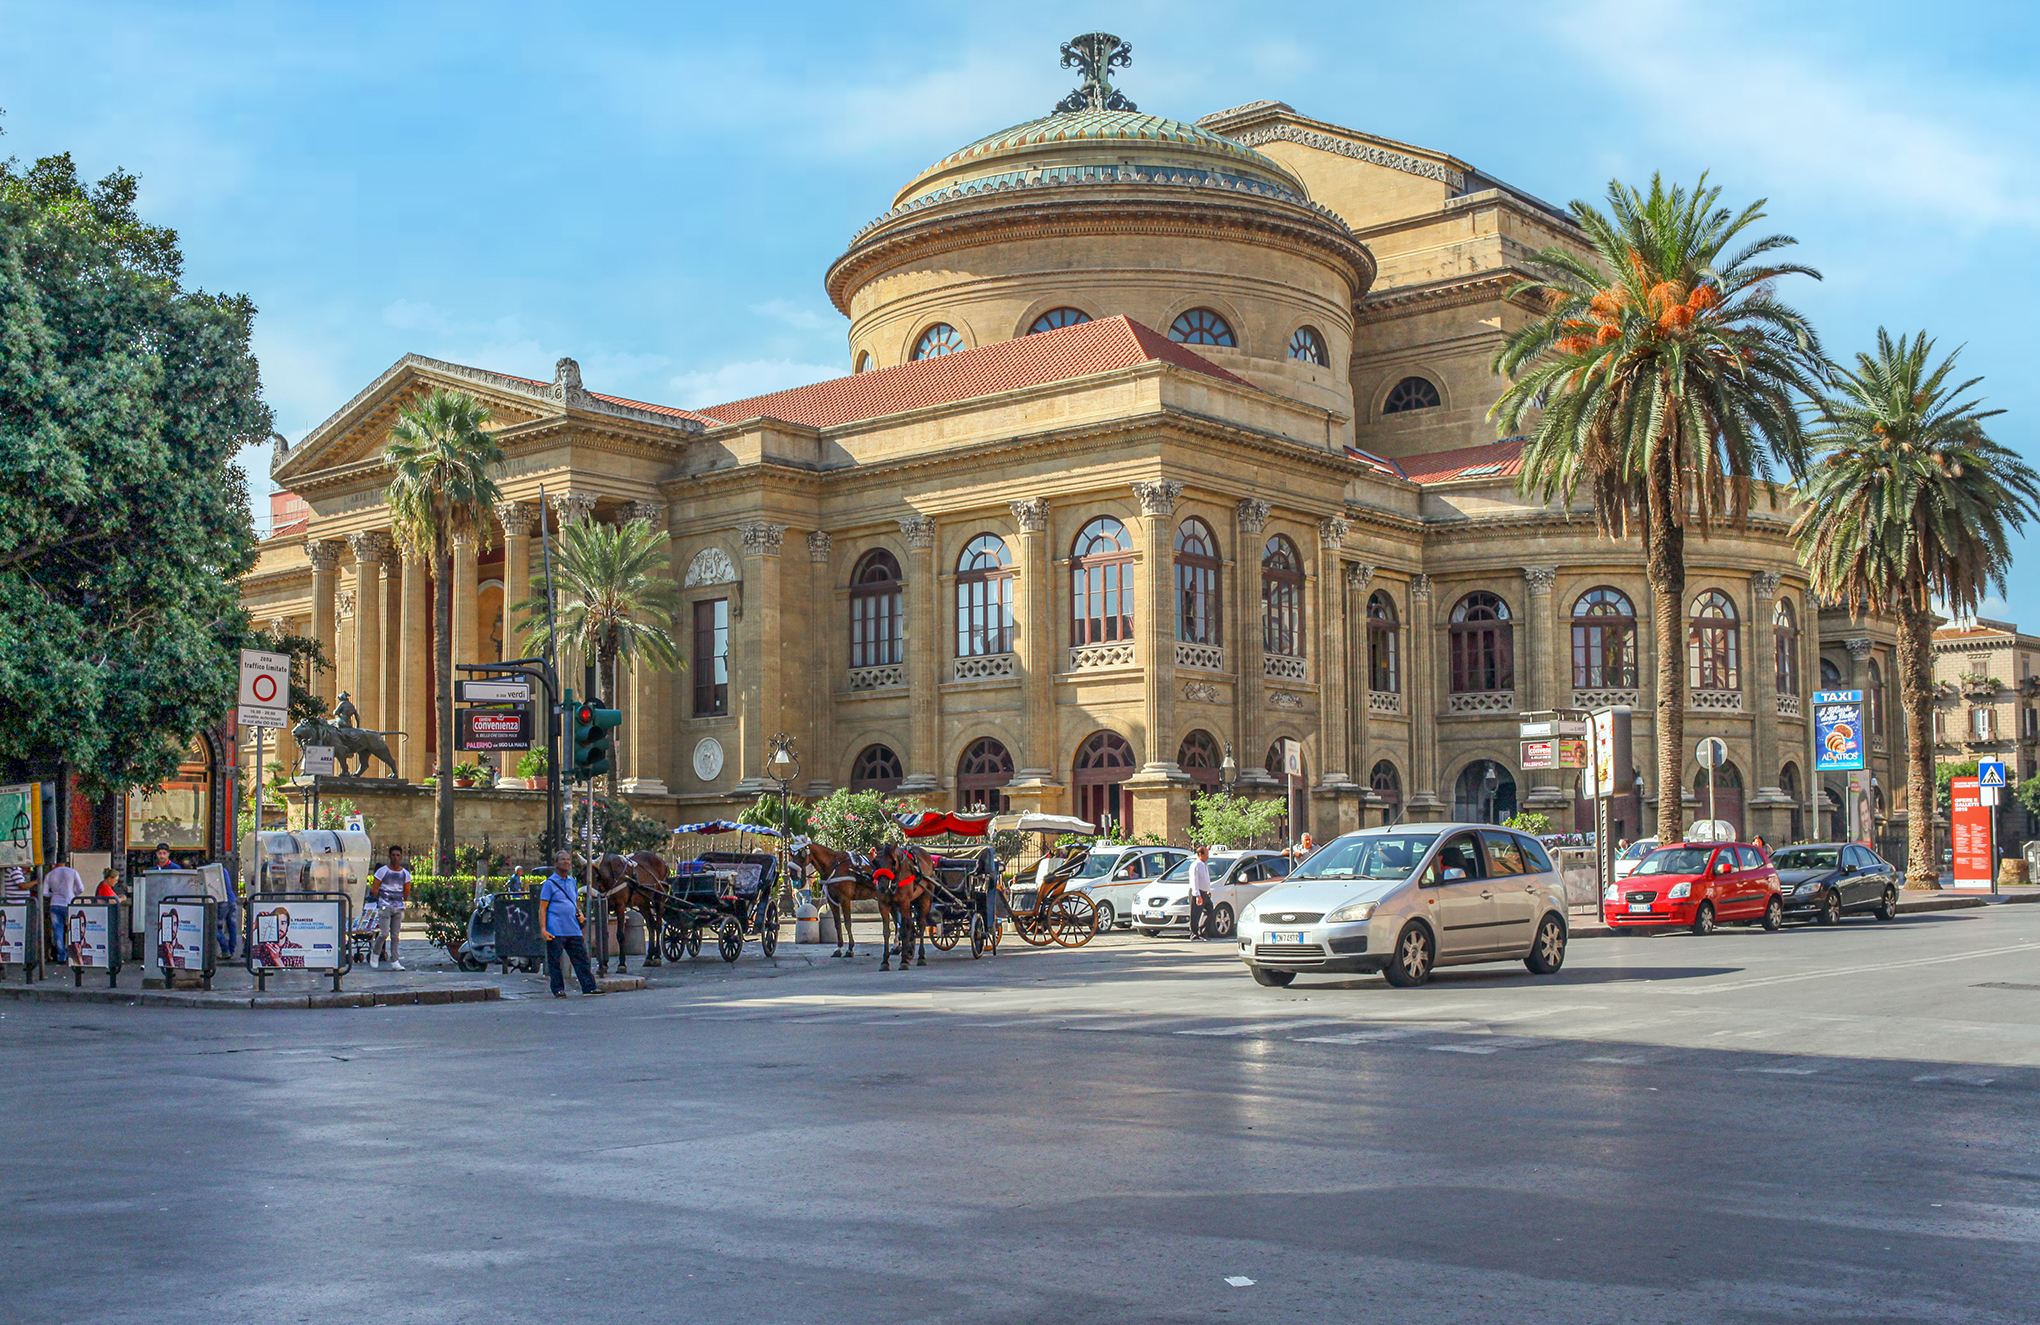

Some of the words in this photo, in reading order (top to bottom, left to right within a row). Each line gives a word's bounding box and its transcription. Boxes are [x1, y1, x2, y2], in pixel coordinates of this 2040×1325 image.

[244, 662, 265, 670] traffico
[266, 663, 287, 672] limitato
[1821, 691, 1853, 702] TAXI
[466, 741, 493, 749] PALERMO
